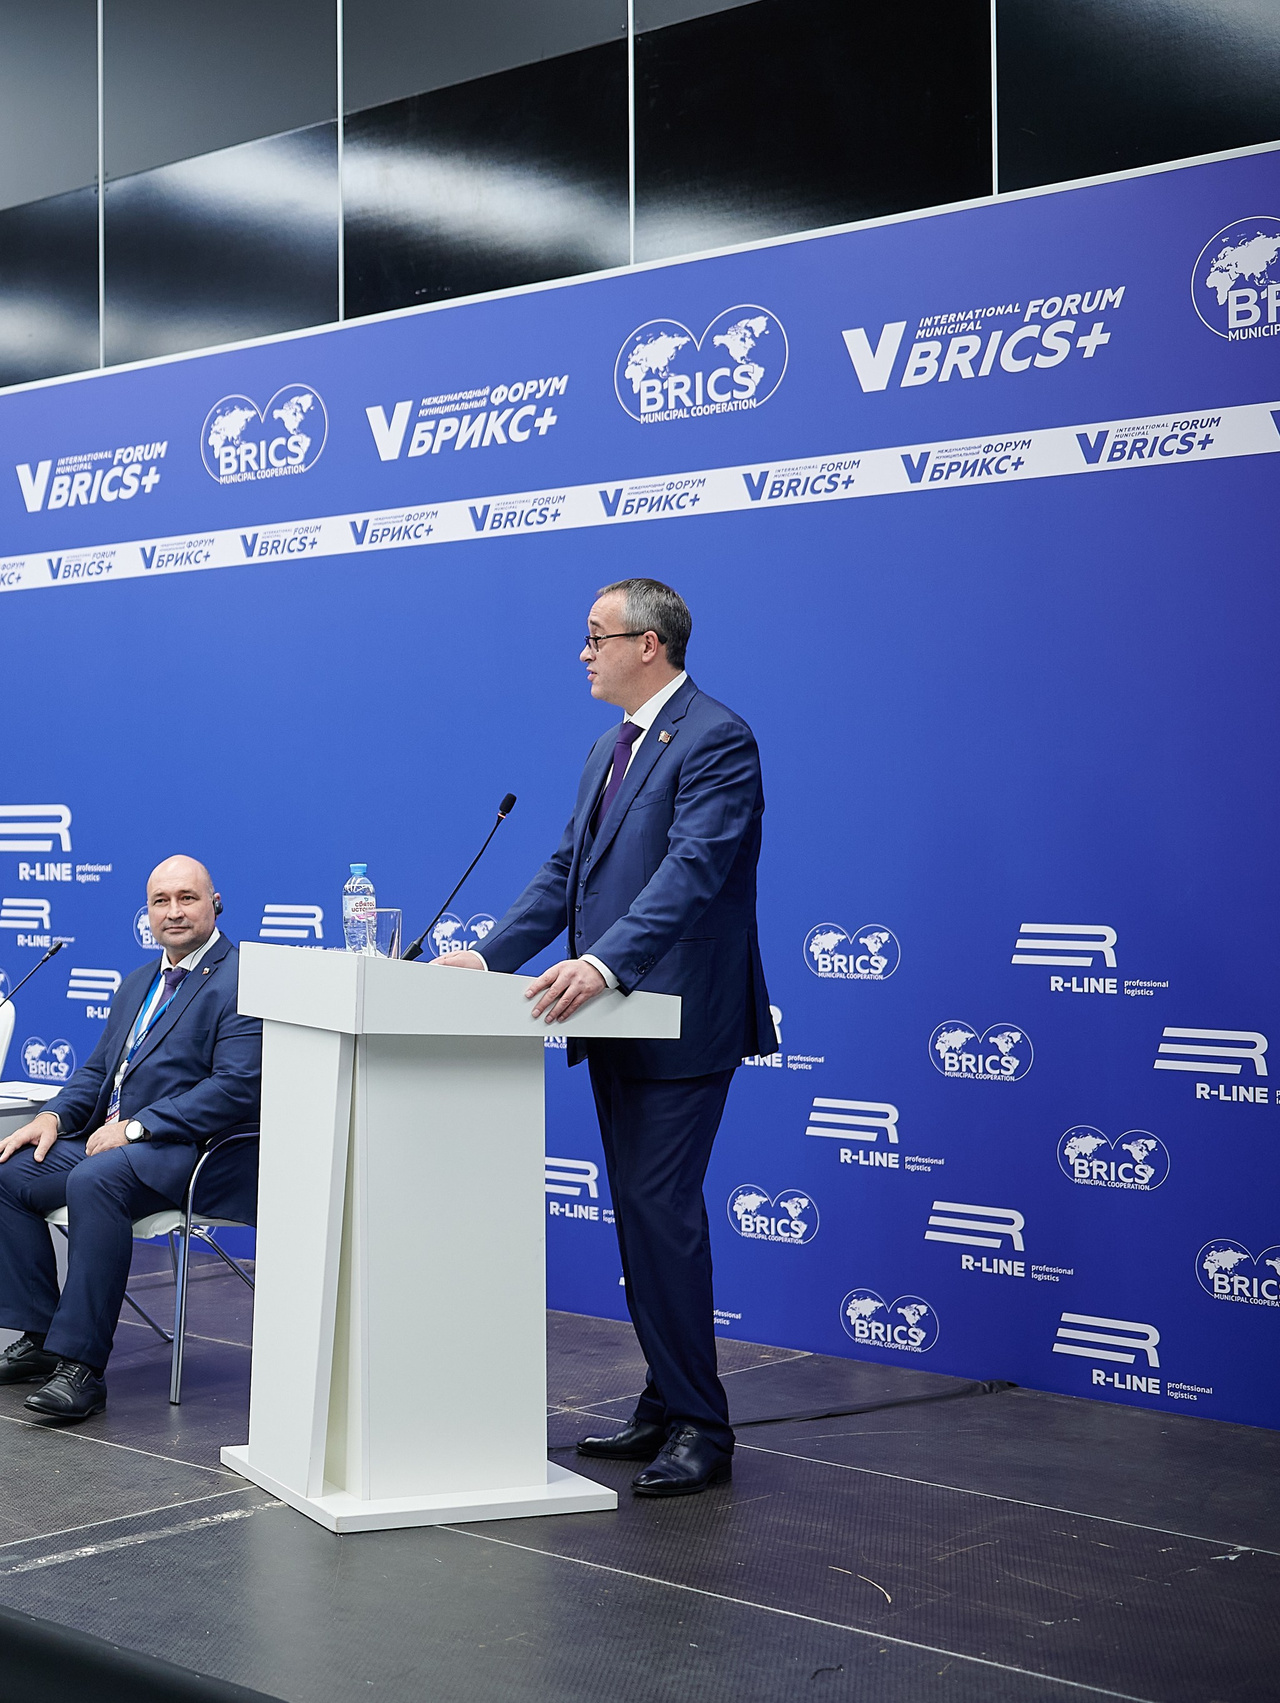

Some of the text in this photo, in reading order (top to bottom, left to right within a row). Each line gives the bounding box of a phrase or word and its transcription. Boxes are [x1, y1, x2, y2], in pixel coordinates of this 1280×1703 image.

[918, 286, 1126, 328] INTERNATIONAL FORUM
[914, 319, 983, 340] MUNICIPAL
[1228, 324, 1280, 341] MUNICIP
[841, 321, 907, 393] V
[901, 319, 1110, 388] BRICS+
[420, 374, 569, 408] МЕЖДУНАРОДНЫЙ ФОРУМ
[639, 363, 756, 415] BRICS
[418, 396, 489, 418] МУНИЦИПАЛЬНЫЙ
[640, 397, 758, 425] MUNICIPAL COOPERATION
[365, 400, 413, 461] V
[412, 404, 557, 457] БРИКС+
[1113, 429, 1150, 440] MUNICIPAL
[1115, 415, 1222, 434] INTERNATIONAL FORUM
[57, 440, 168, 467] INTERNATIONAL FORUM
[219, 432, 305, 476] BRICS
[982, 438, 1032, 455] ФОРУМ
[1075, 429, 1109, 465] V
[1106, 430, 1215, 463] BRICS+
[55, 460, 93, 476] MUNICIPAL
[219, 463, 305, 485] MUNICIPAL COOPERATION
[818, 459, 860, 474] FORUM
[899, 451, 931, 484] V
[928, 454, 1025, 483] БРИКС+
[15, 459, 52, 513] V
[47, 462, 160, 510] BRICS+
[665, 477, 706, 492] ФОРУМ
[741, 470, 770, 502] V
[766, 472, 855, 501] BRICS+
[531, 494, 566, 508] FORUM
[598, 487, 624, 518] V
[621, 491, 701, 517] БРИКС+
[405, 510, 439, 523] ФОРУМ
[468, 503, 492, 533] V
[489, 506, 562, 532] BRICS+
[293, 524, 322, 536] FORUM
[349, 518, 371, 546] V
[368, 522, 435, 545] БРИКС+
[187, 537, 216, 549] ФОРУМ
[240, 531, 260, 559] V
[257, 535, 318, 558] BRICS+
[92, 549, 117, 560] FORUM
[139, 544, 158, 570] V
[156, 548, 212, 569] БРИКС+
[46, 555, 64, 580] V
[61, 559, 114, 580] BRICS+
[18, 862, 73, 882] R-LINE
[75, 863, 112, 873] professional
[75, 872, 100, 883] logistics
[17, 934, 52, 947] R-LINE
[439, 940, 478, 956] BRI
[818, 953, 884, 975] BRICS
[846, 973, 883, 981] COOPERATION
[1050, 976, 1118, 994] R-LINE
[1124, 980, 1169, 988] professional
[1124, 988, 1154, 997] logistics
[86, 1006, 111, 1019] R-LI
[30, 1060, 68, 1077] BRICS
[741, 1052, 783, 1068] -LINE
[787, 1054, 825, 1063] professional
[787, 1062, 812, 1070] logistics
[944, 1053, 1015, 1075] BRICS
[944, 1071, 1015, 1081] MUNICIPAL COOPERATION
[1196, 1083, 1269, 1104] R-LINE
[840, 1148, 900, 1169] R-LINE
[905, 1156, 945, 1165] professional
[905, 1163, 932, 1173] logistics
[1074, 1159, 1150, 1184] BRICS
[1074, 1178, 1150, 1191] MUNICIPAL COOPERATION
[549, 1201, 599, 1221] R-LINE
[741, 1214, 803, 1238] BRICS
[741, 1232, 803, 1245] MUNICIPAL COOPERATION
[961, 1254, 1026, 1278] R-LINE
[1031, 1265, 1074, 1275] professional
[1031, 1272, 1060, 1282] logistics
[1213, 1273, 1280, 1300] BRIC
[1214, 1293, 1280, 1307] MUNICIPAL COOPERA
[855, 1319, 921, 1346] BRICS
[855, 1338, 922, 1353] MUNICIPAL COOPERATION
[1092, 1369, 1161, 1395] R-LINE
[1167, 1382, 1213, 1395] professional
[1167, 1390, 1198, 1401] logistics
